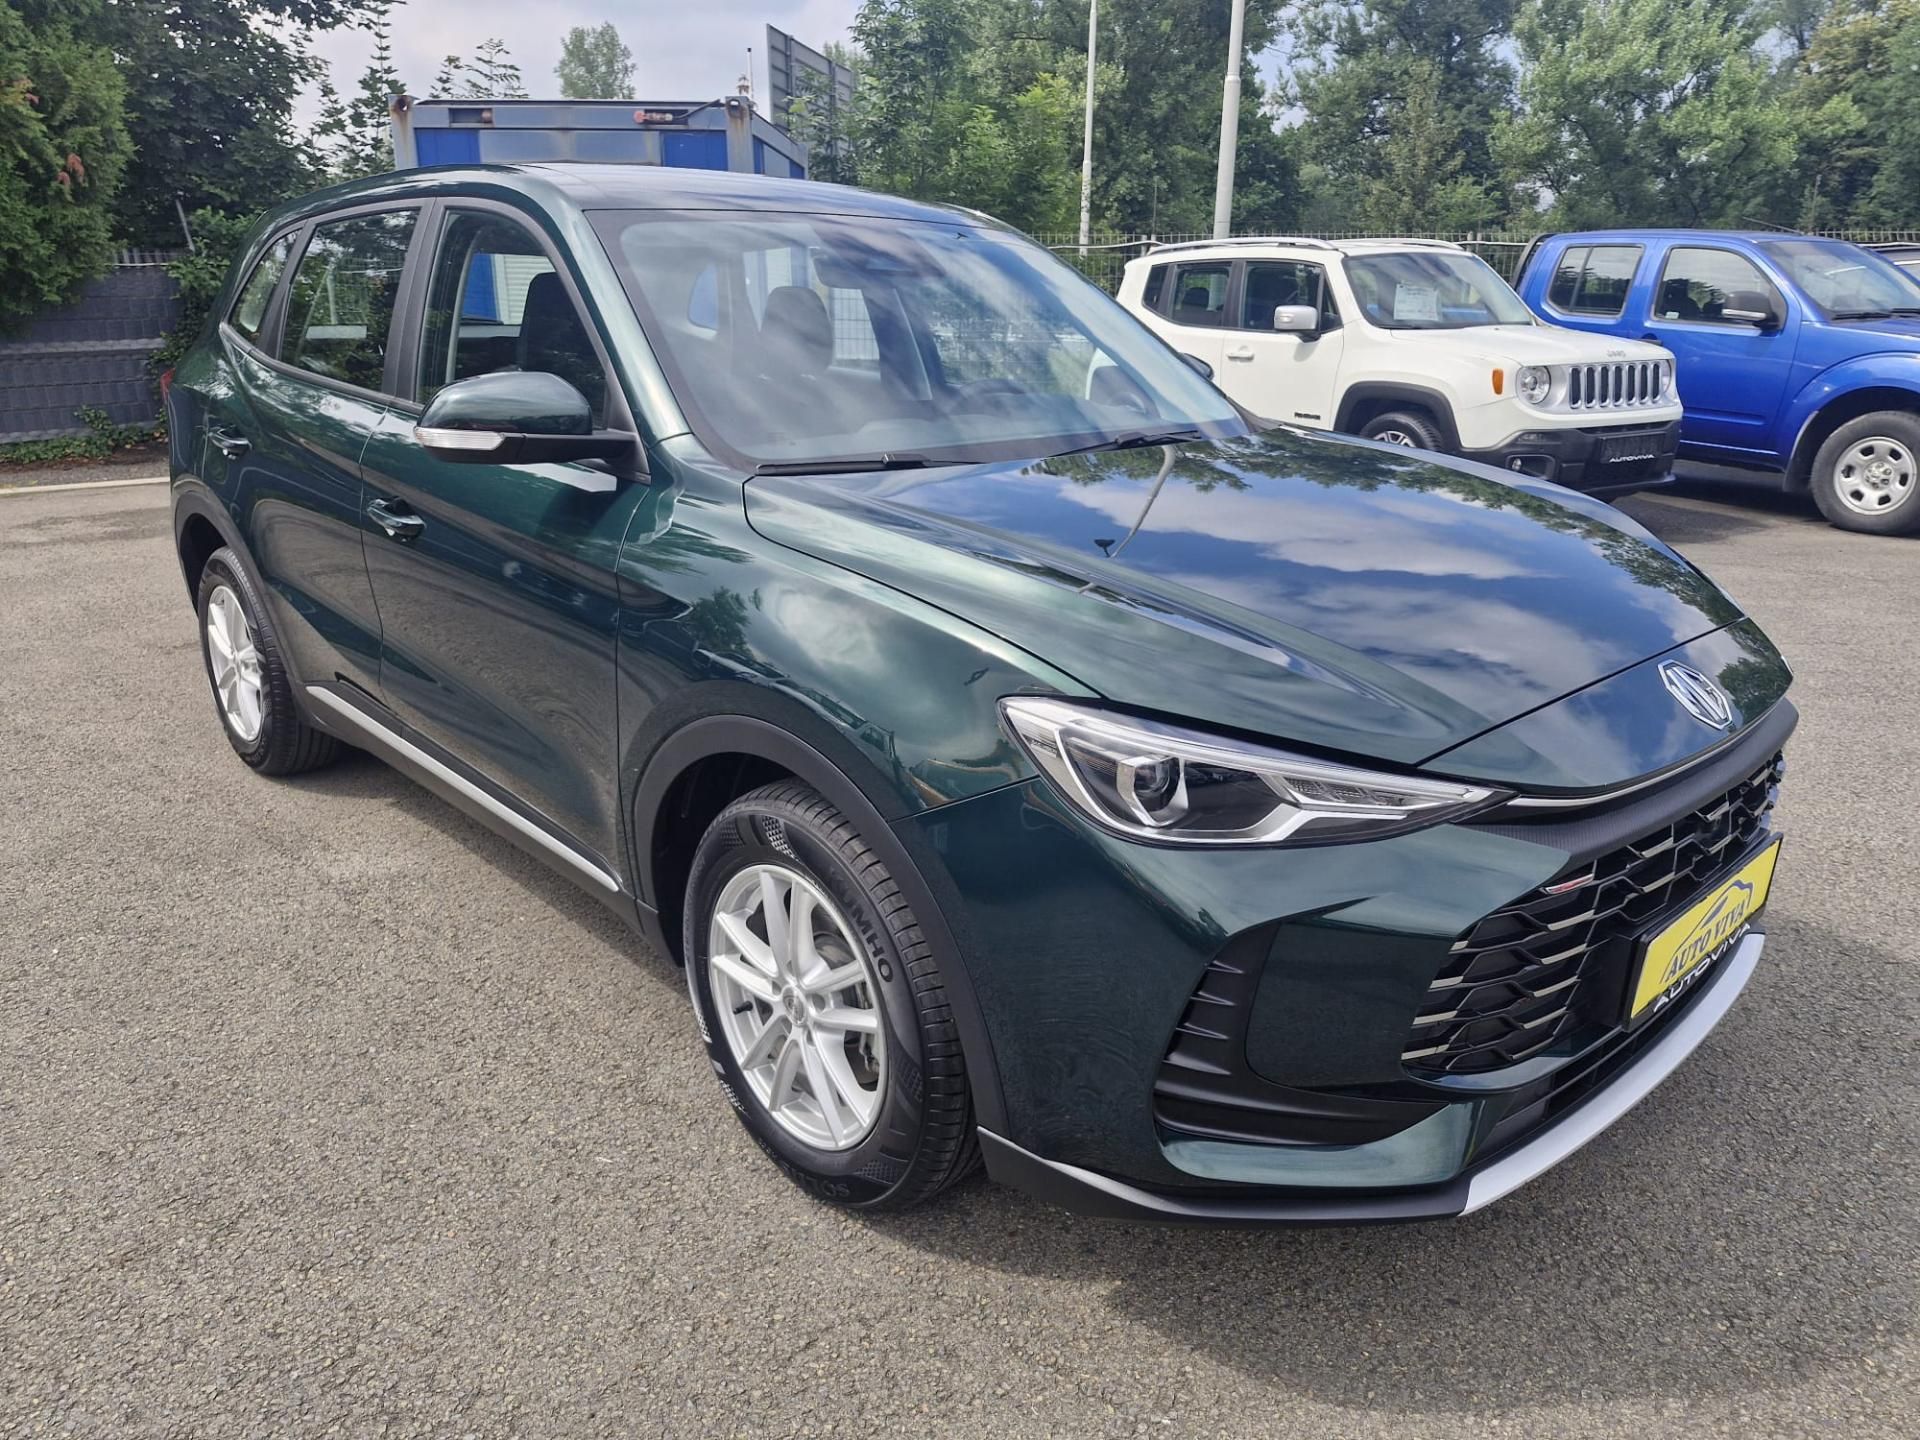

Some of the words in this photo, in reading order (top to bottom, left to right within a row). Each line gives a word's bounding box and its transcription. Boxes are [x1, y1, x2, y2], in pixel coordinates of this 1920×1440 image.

[1609, 454, 1655, 463] AUTOVIVA
[1664, 665, 1728, 722] MG
[1653, 922, 1750, 1012] AUTOVIVA
[1664, 928, 1712, 983] AUTO
[1713, 899, 1745, 941] VIVA
